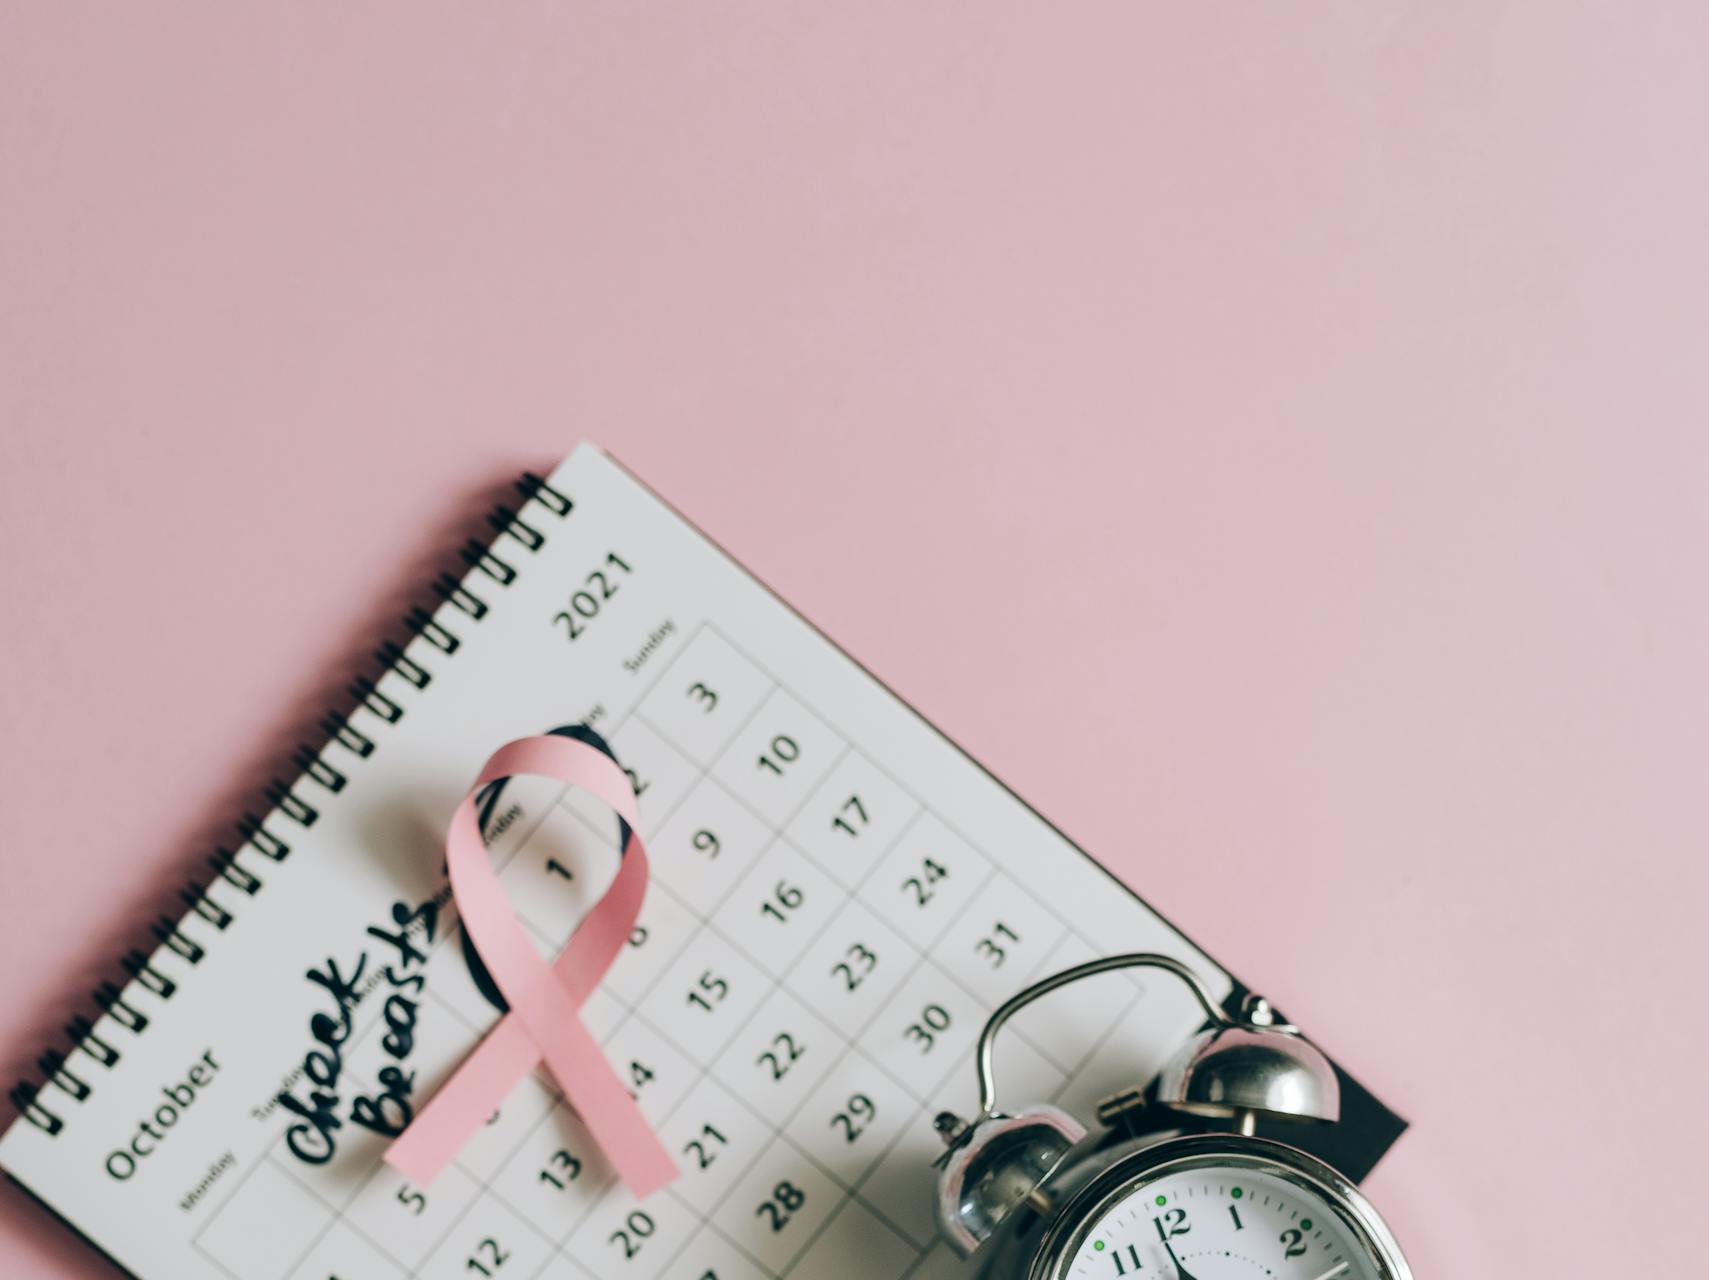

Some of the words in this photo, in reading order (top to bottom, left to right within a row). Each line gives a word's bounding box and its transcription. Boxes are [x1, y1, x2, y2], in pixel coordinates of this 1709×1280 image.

[552, 551, 632, 642] 2021
[543, 856, 575, 883] 1
[688, 682, 719, 713] 3
[179, 1150, 237, 1212] Monday
[623, 616, 676, 676] Sunday
[397, 1183, 427, 1216] 5
[691, 829, 721, 860] 9
[757, 734, 801, 777] 10
[104, 1048, 221, 1182] October
[465, 1237, 511, 1280] 12
[538, 1147, 586, 1193] 13
[685, 970, 730, 1014] 15
[760, 880, 805, 924] 16
[831, 794, 872, 838] 17
[608, 1209, 657, 1261] 20
[683, 1122, 730, 1170] 21
[756, 1031, 806, 1082] 22
[831, 942, 879, 993] 23
[901, 856, 949, 908] 24
[755, 1179, 807, 1234] 28
[829, 1092, 877, 1144] 29
[903, 1003, 952, 1054] 30
[974, 921, 1021, 969] 31
[1110, 1243, 1143, 1277] 11
[1152, 1207, 1192, 1243] 12
[1228, 1204, 1245, 1232] 1
[1279, 1228, 1307, 1261] 2
